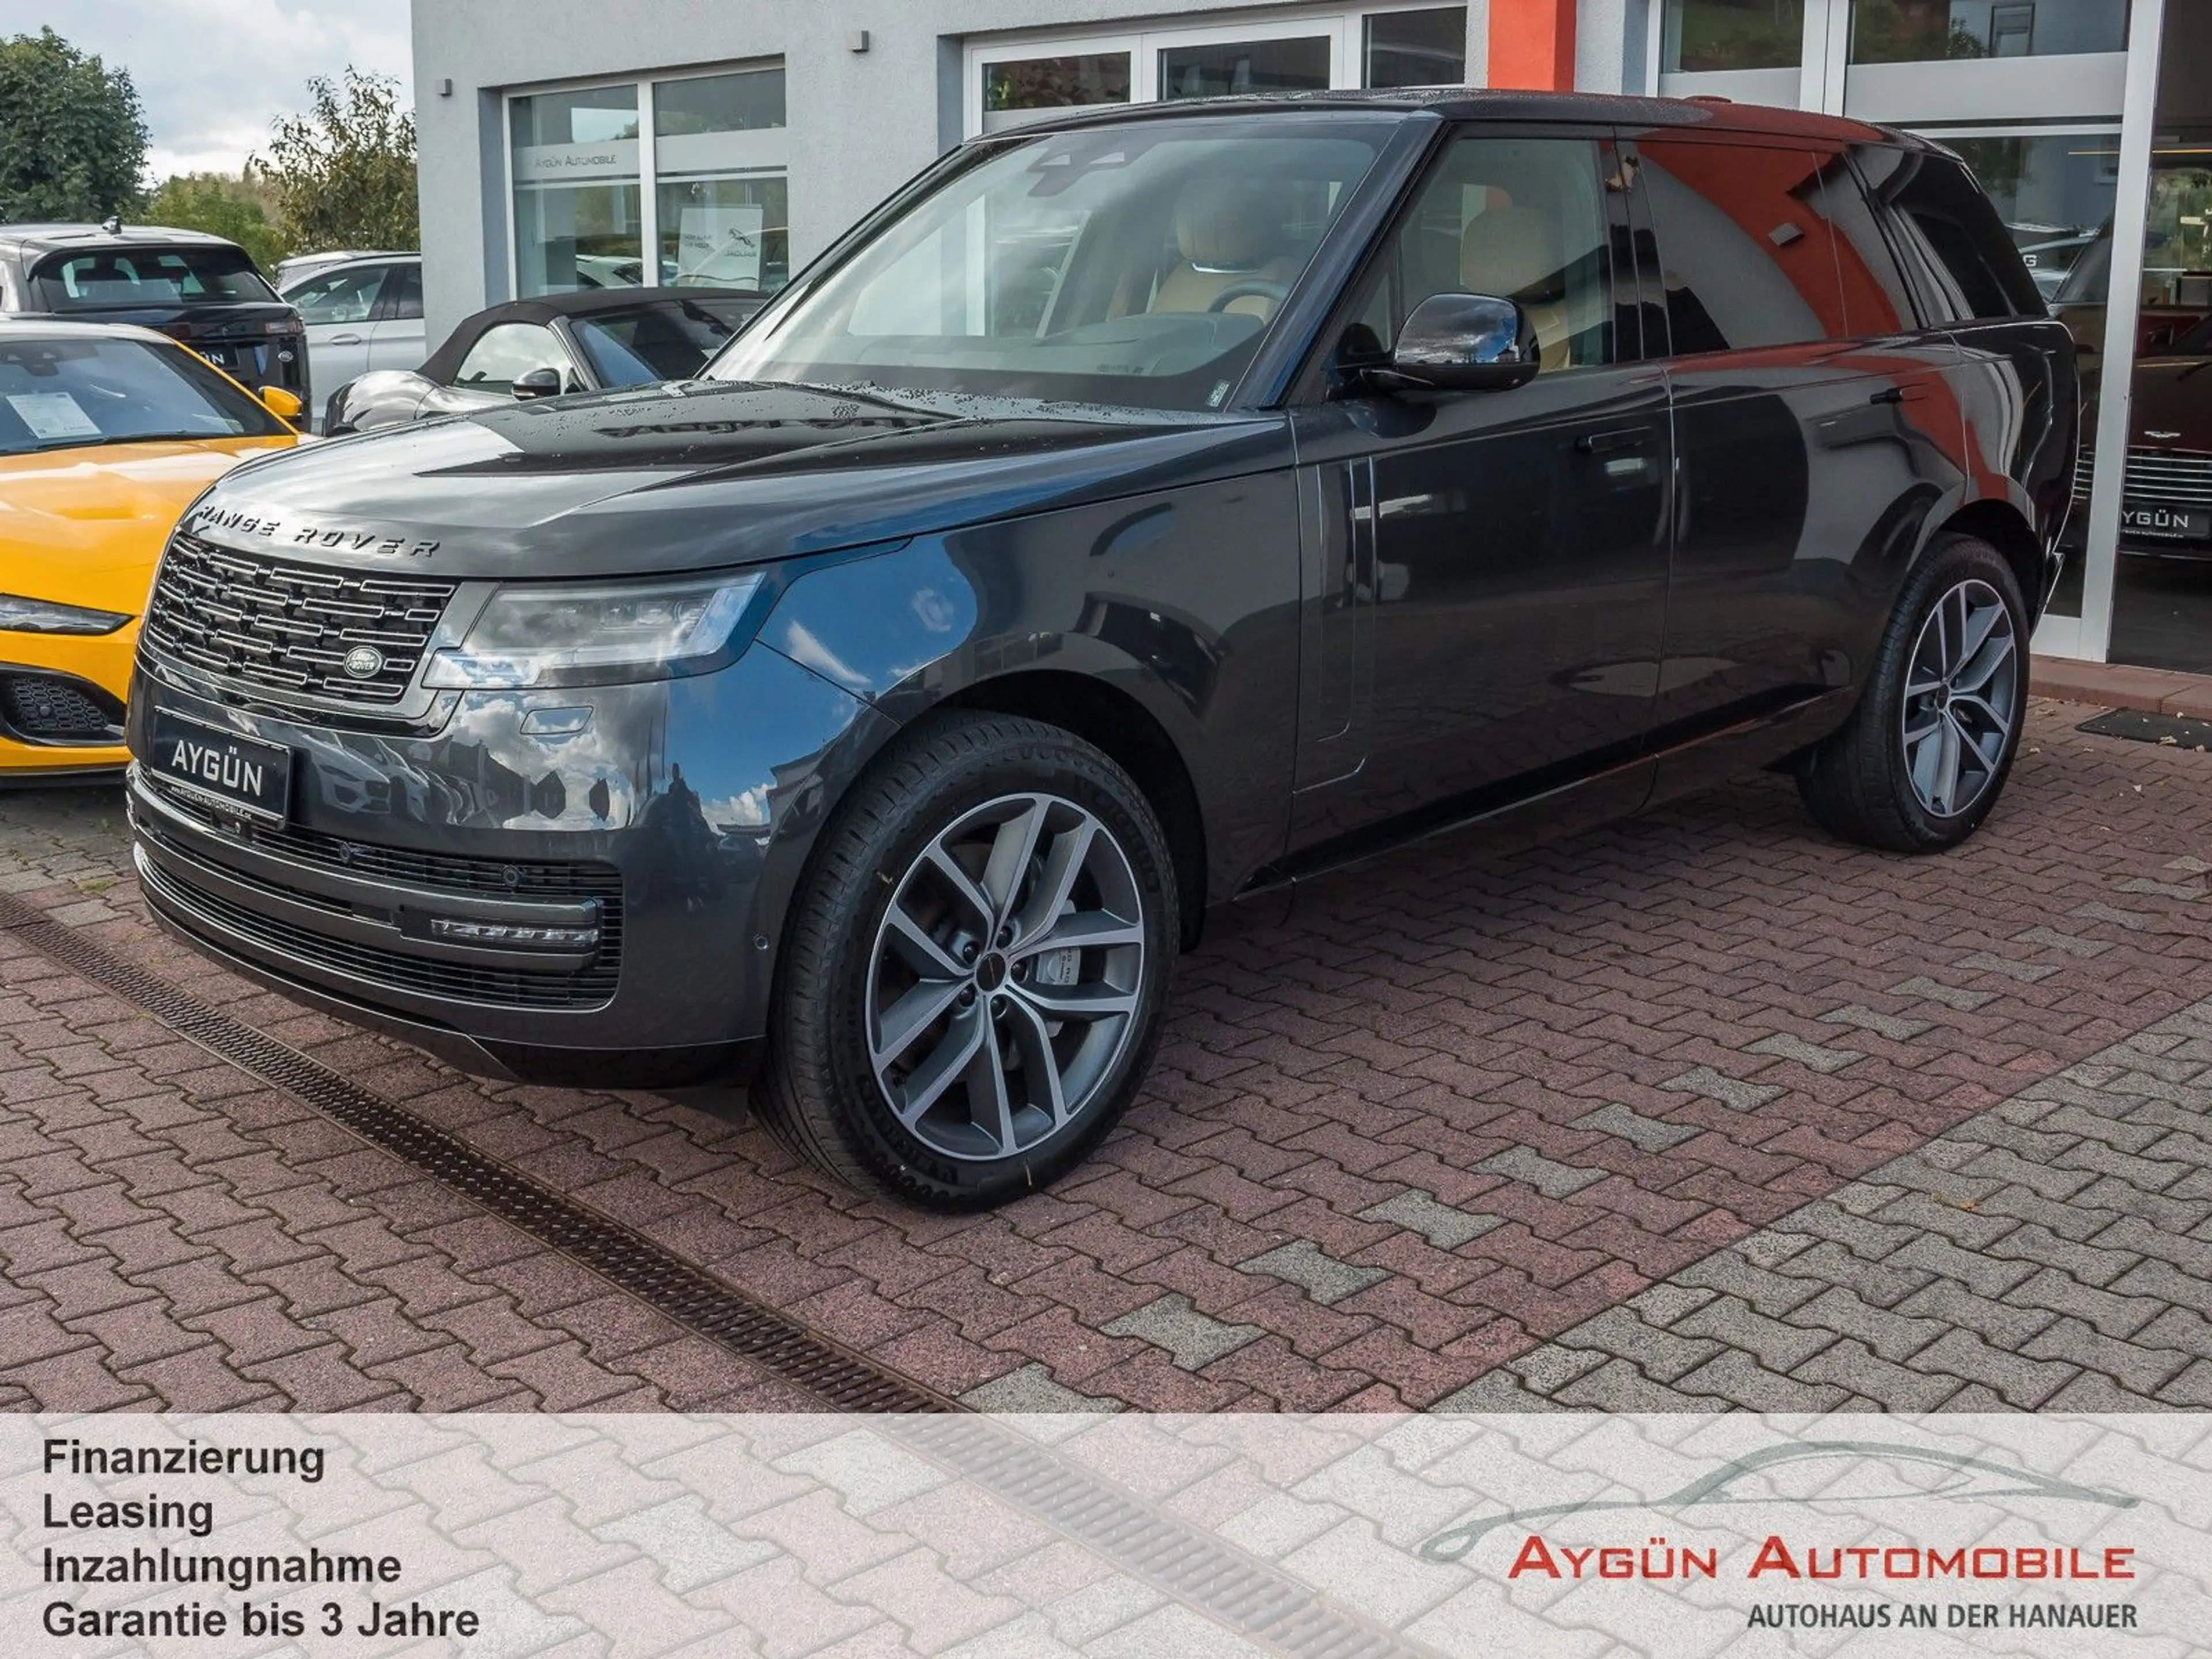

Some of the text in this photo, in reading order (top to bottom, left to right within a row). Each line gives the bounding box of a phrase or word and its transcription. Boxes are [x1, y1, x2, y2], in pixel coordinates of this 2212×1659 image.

[198, 505, 441, 558] RANGE ROVER
[2122, 509, 2189, 528] YGÜN
[171, 739, 263, 797] AYGÜN
